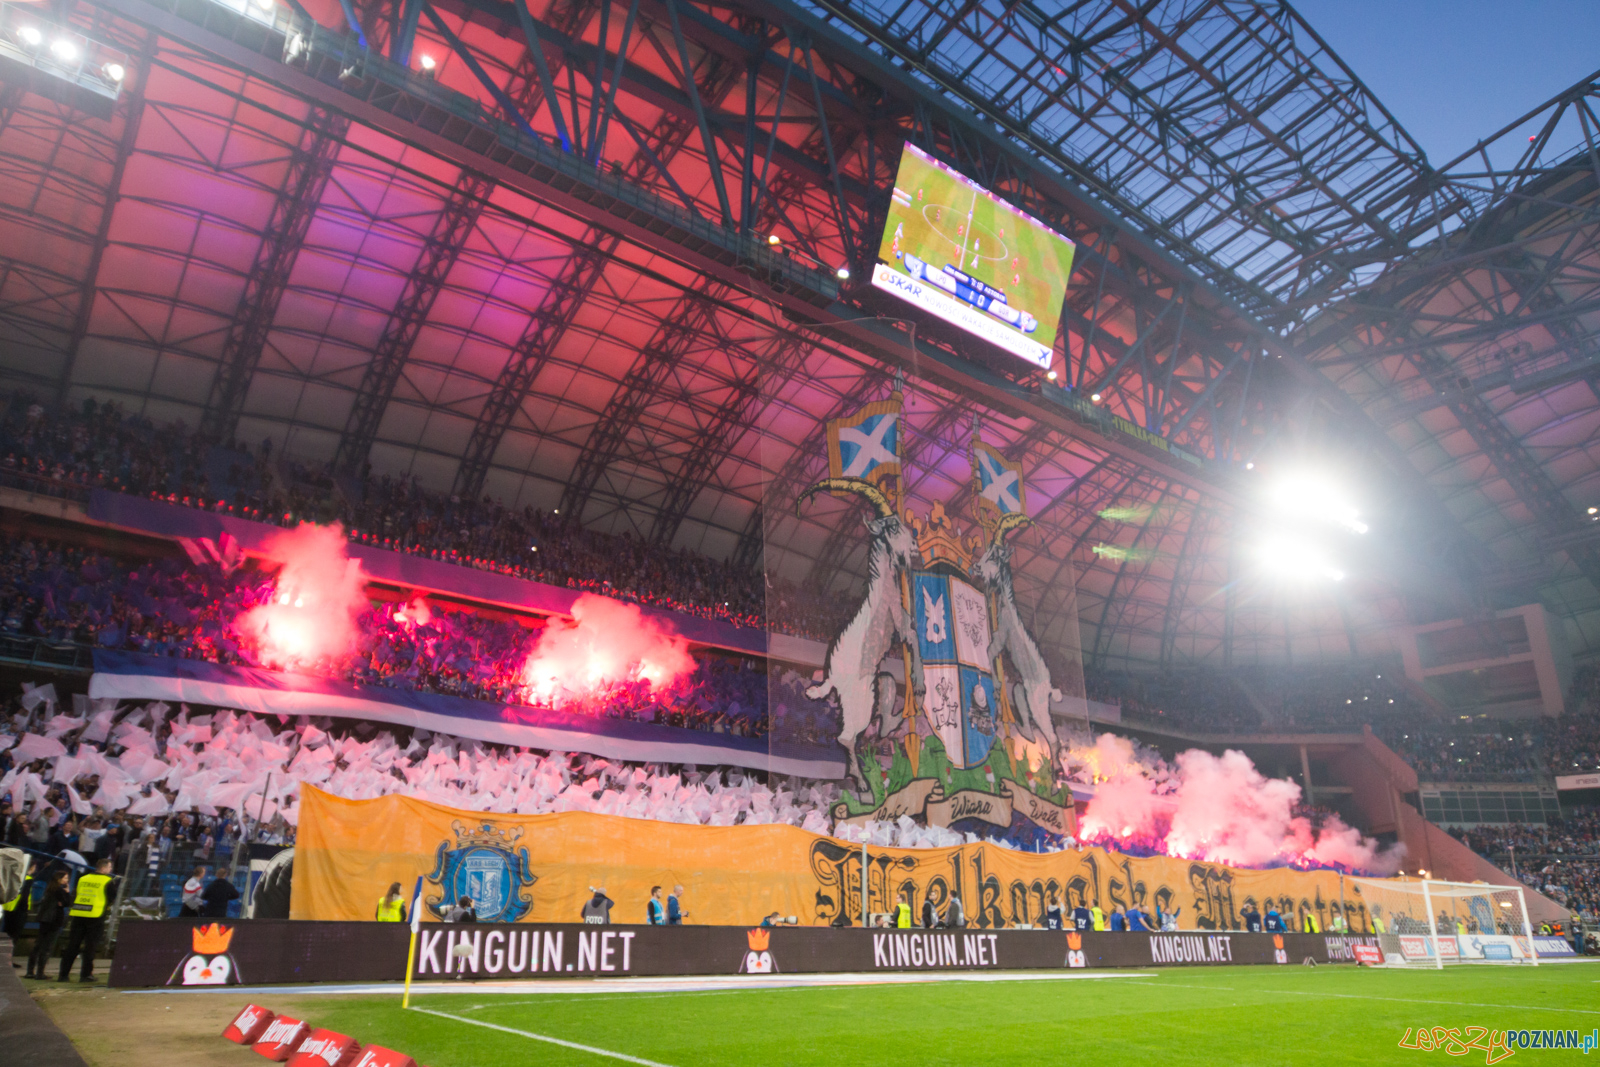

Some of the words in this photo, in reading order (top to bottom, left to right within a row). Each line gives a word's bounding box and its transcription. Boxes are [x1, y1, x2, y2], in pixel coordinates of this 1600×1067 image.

[879, 271, 922, 298] OSKAR
[951, 796, 993, 819] Wiara
[585, 915, 603, 924] FOTO
[1048, 918, 1058, 927] TV
[1077, 918, 1087, 926] TV
[418, 929, 635, 974] KINGUIN.NET
[873, 933, 998, 967] KINGUIN.NET
[1149, 935, 1233, 963] KINGUIN.NET
